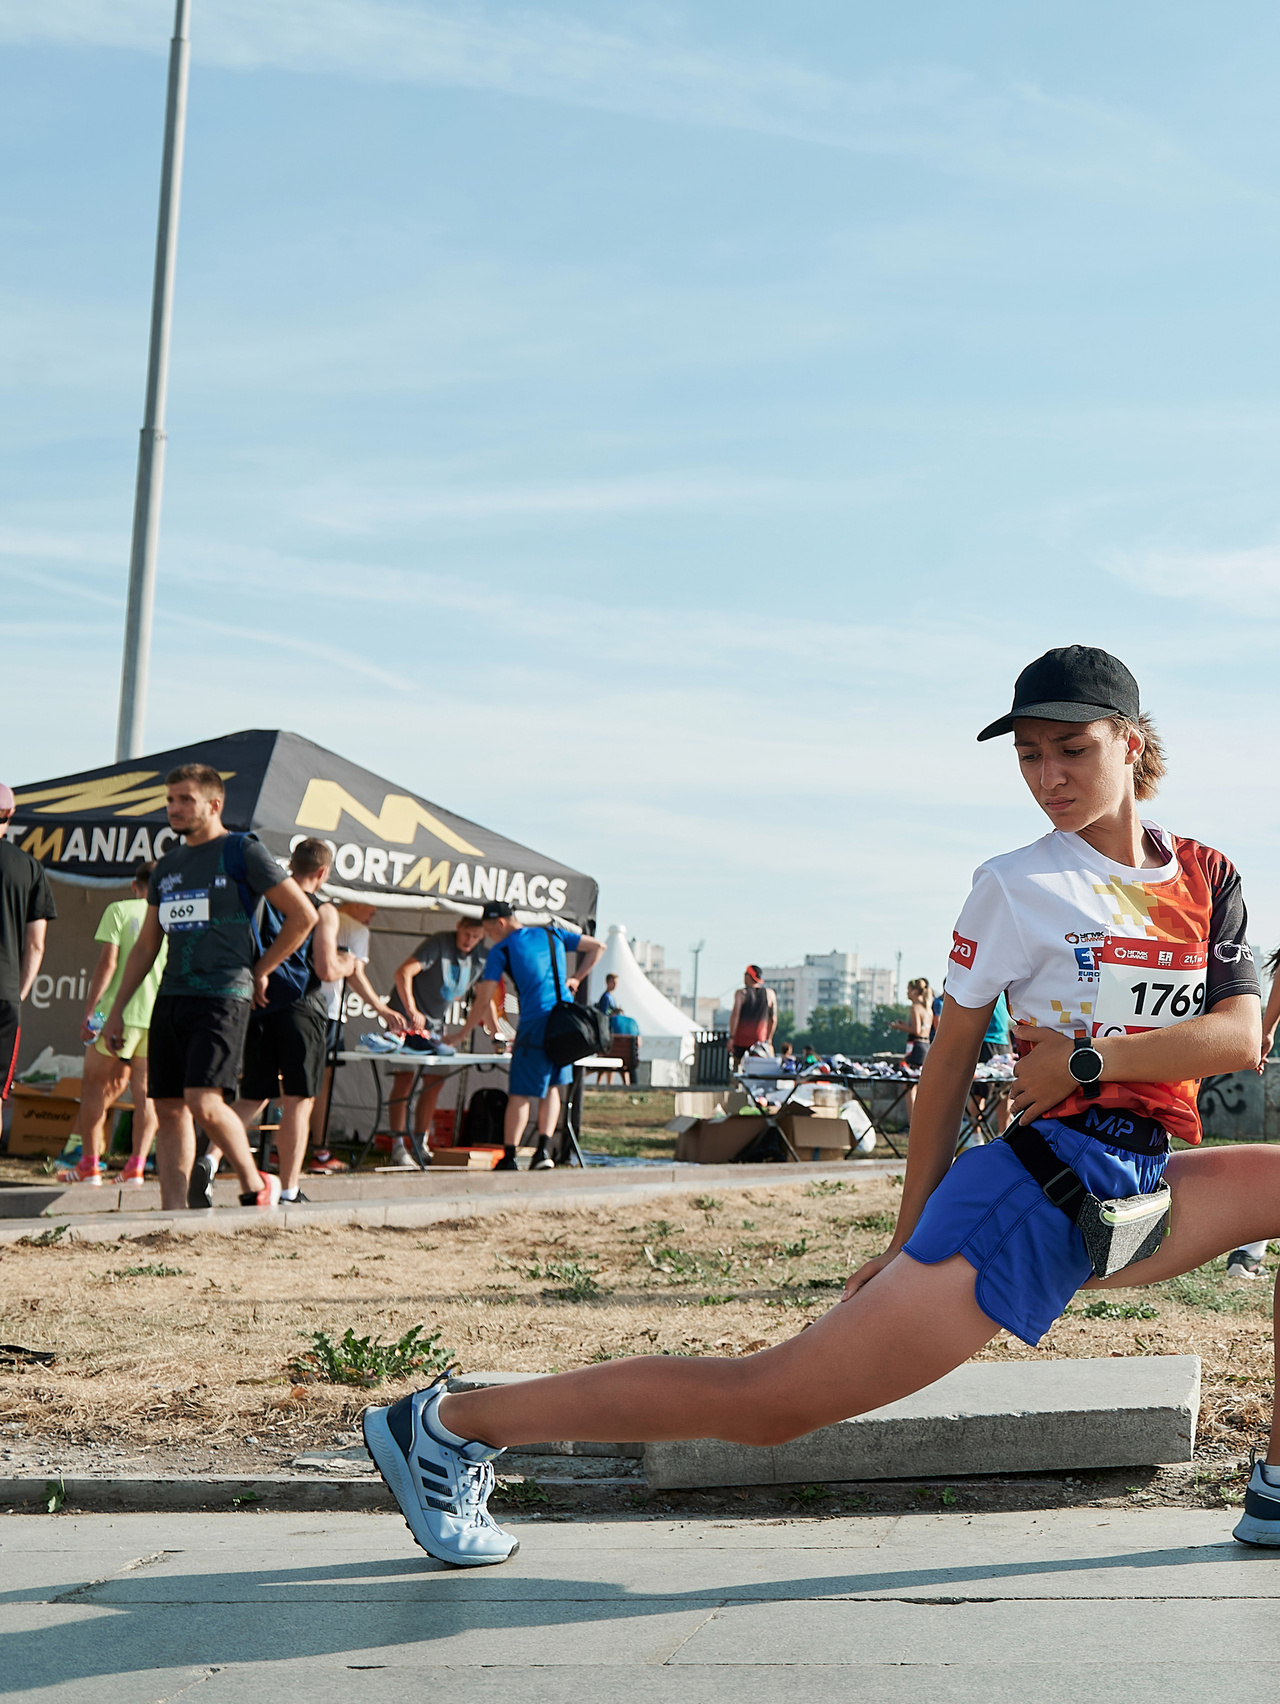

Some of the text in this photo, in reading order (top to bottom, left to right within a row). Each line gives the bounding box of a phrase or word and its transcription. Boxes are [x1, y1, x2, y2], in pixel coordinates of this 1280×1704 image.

[4, 826, 187, 862] TMANIAC
[169, 904, 194, 918] 669
[1131, 982, 1204, 1017] 1769
